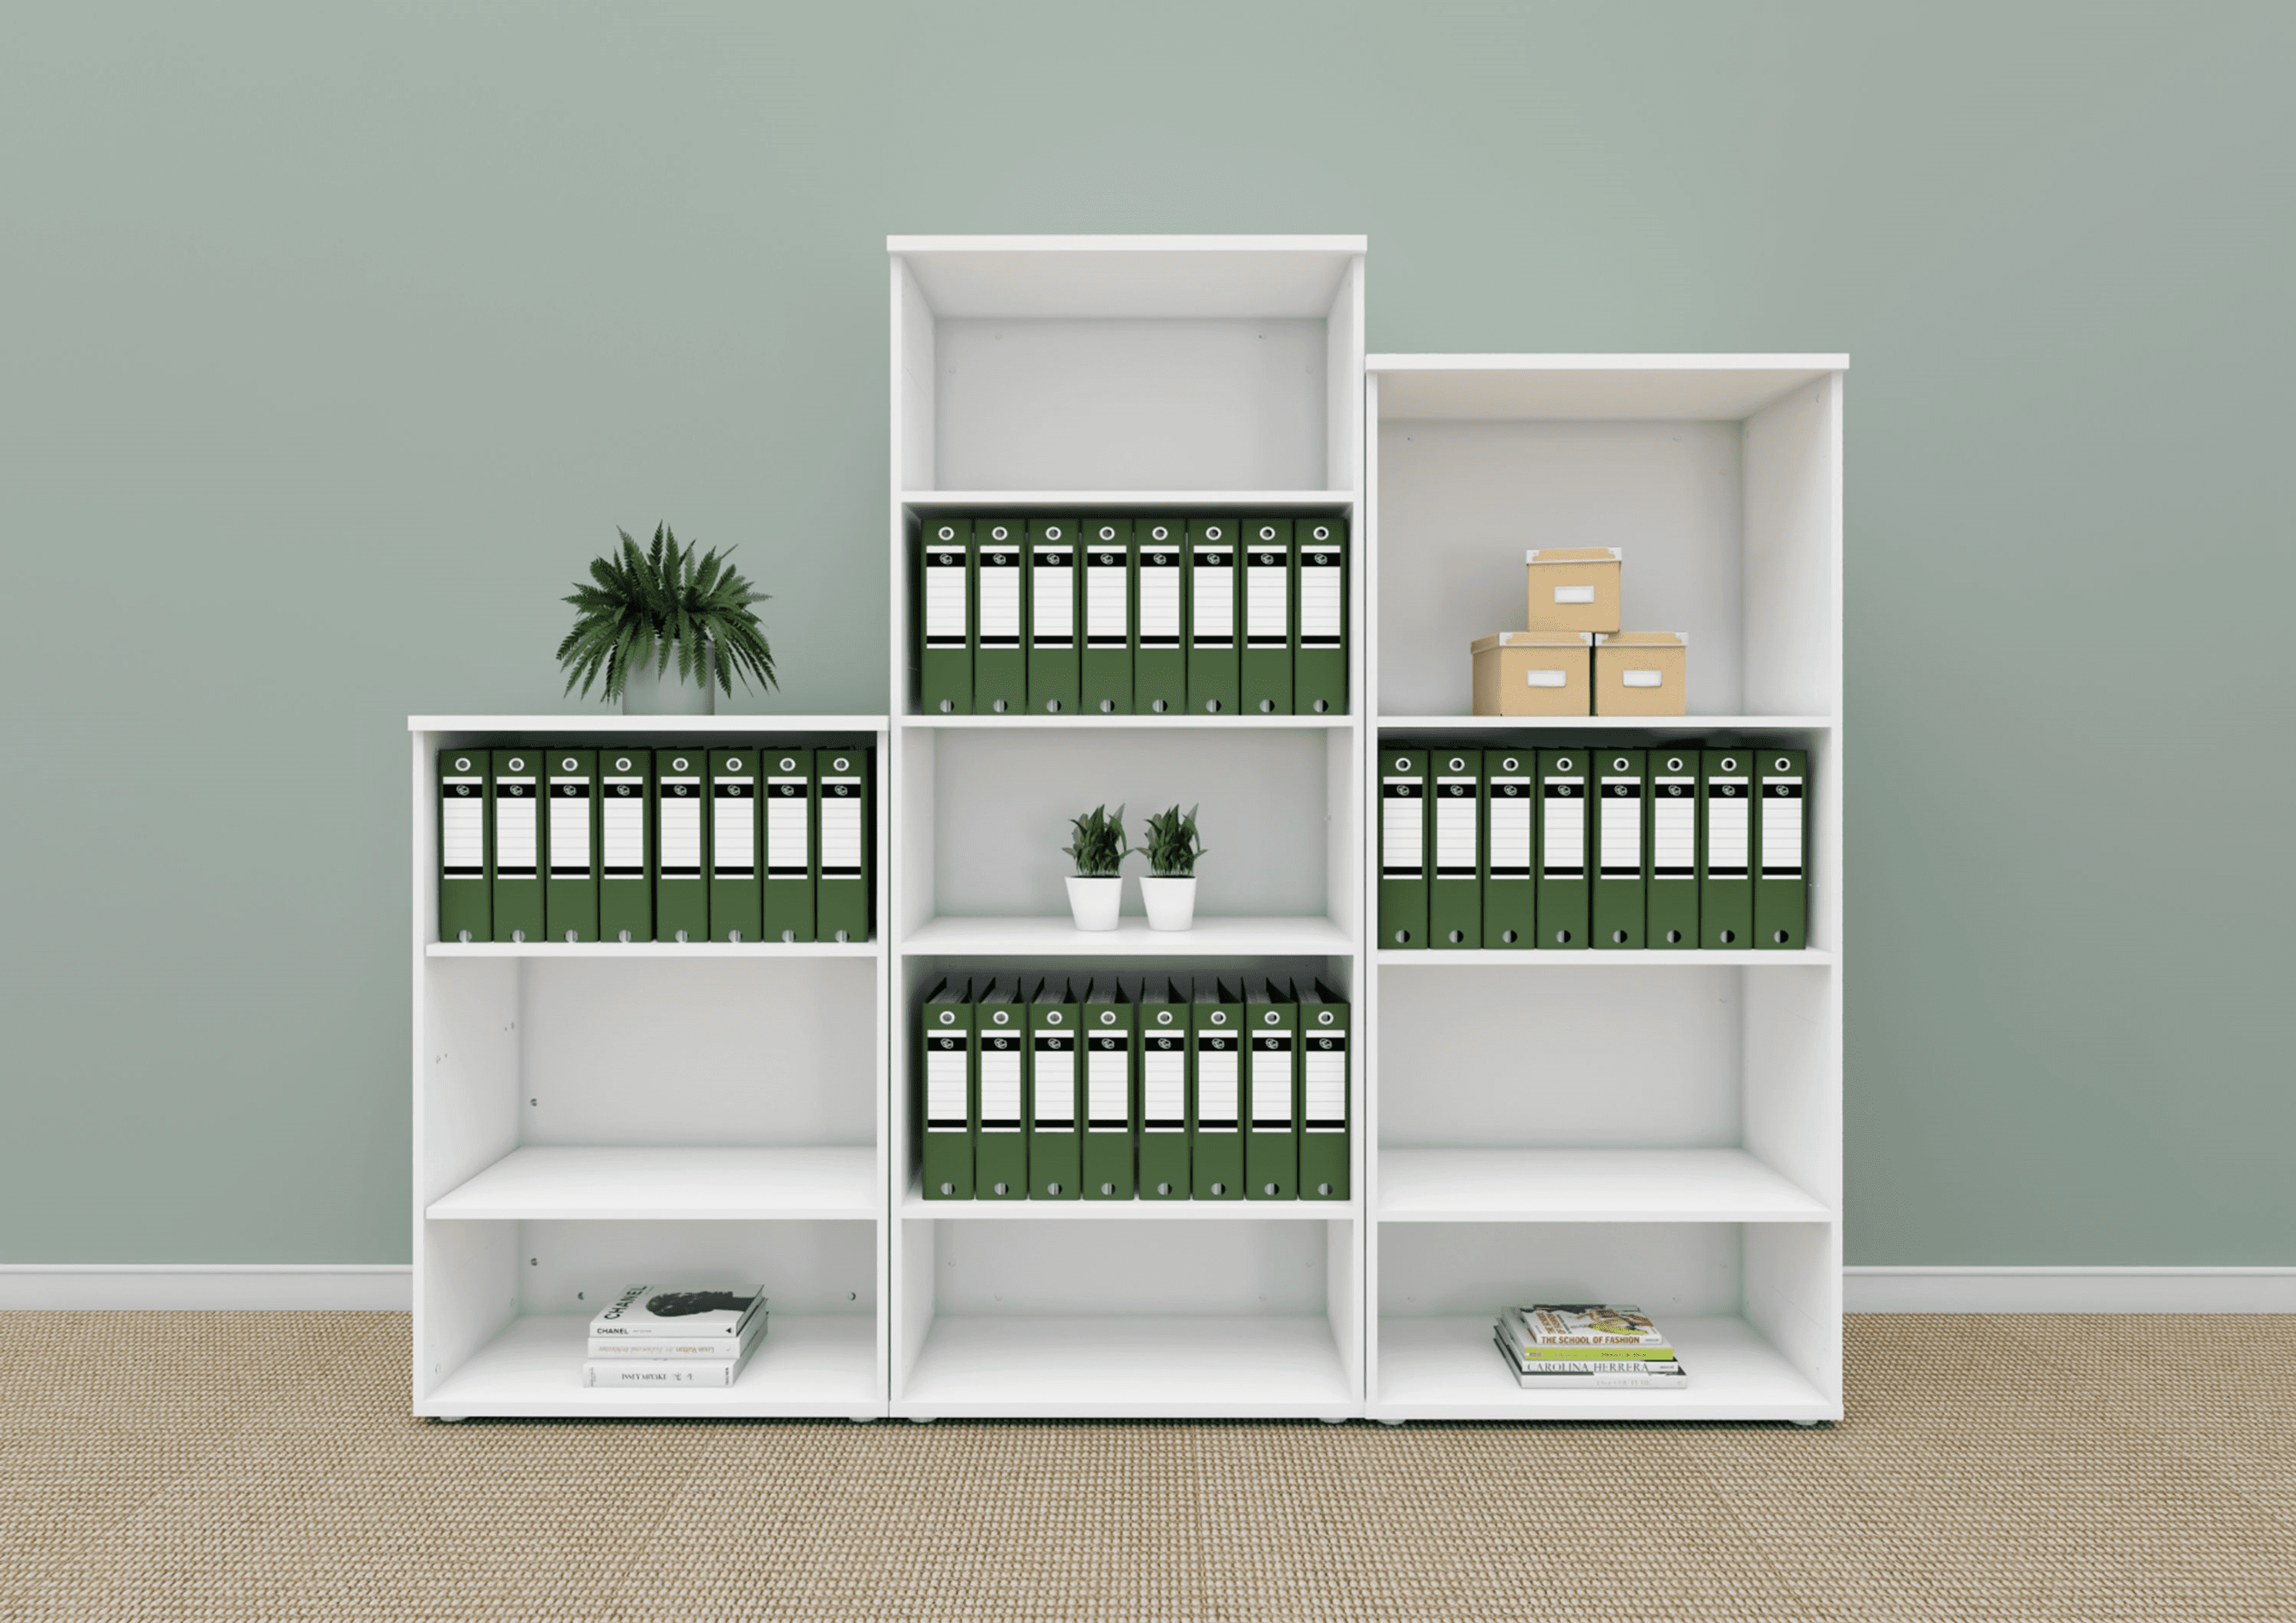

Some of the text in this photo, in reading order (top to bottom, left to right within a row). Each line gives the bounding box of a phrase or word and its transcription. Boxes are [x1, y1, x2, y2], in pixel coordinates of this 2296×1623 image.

[604, 1286, 647, 1320] CHANEL
[1542, 1336, 1557, 1344] THE
[1559, 1336, 1589, 1344] SCHOOL
[1593, 1336, 1603, 1344] OF
[1605, 1336, 1640, 1344] FASHION
[1527, 1363, 1649, 1373] CAROLINA HERRERA
